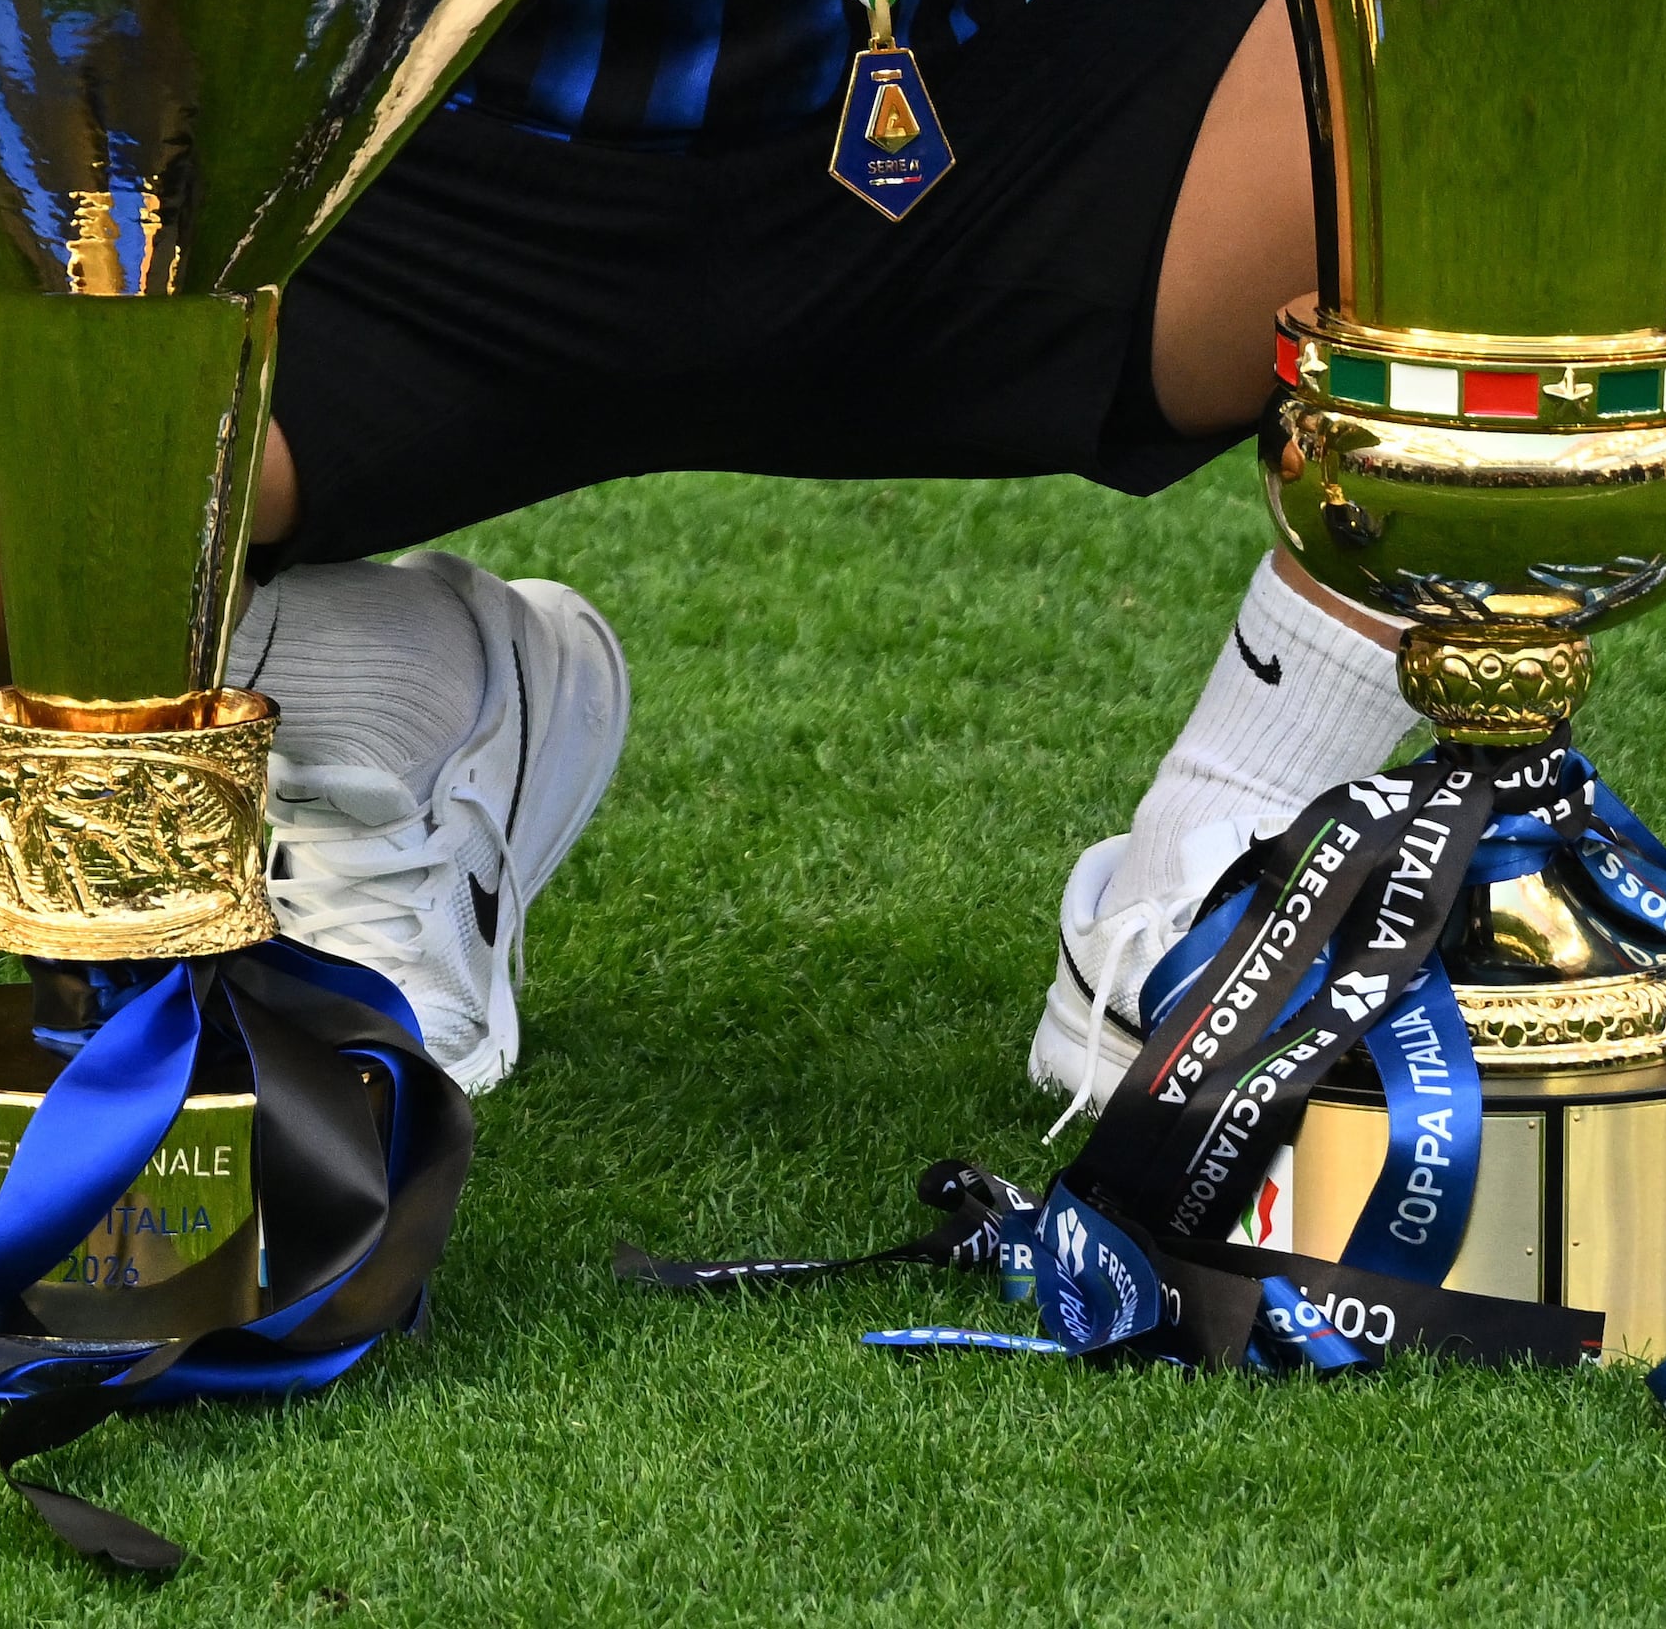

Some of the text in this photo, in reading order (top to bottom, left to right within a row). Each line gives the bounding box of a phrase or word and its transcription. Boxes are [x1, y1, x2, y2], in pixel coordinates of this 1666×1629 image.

[867, 158, 907, 174] SERIE
[1158, 822, 1361, 1105] FRECCIAROSSA
[1367, 818, 1451, 949] ITALIA
[1169, 1029, 1339, 1236] FRECCIAROSSA
[1389, 1005, 1454, 1245] COPPA ITALIA
[62, 1254, 140, 1287] 2026
